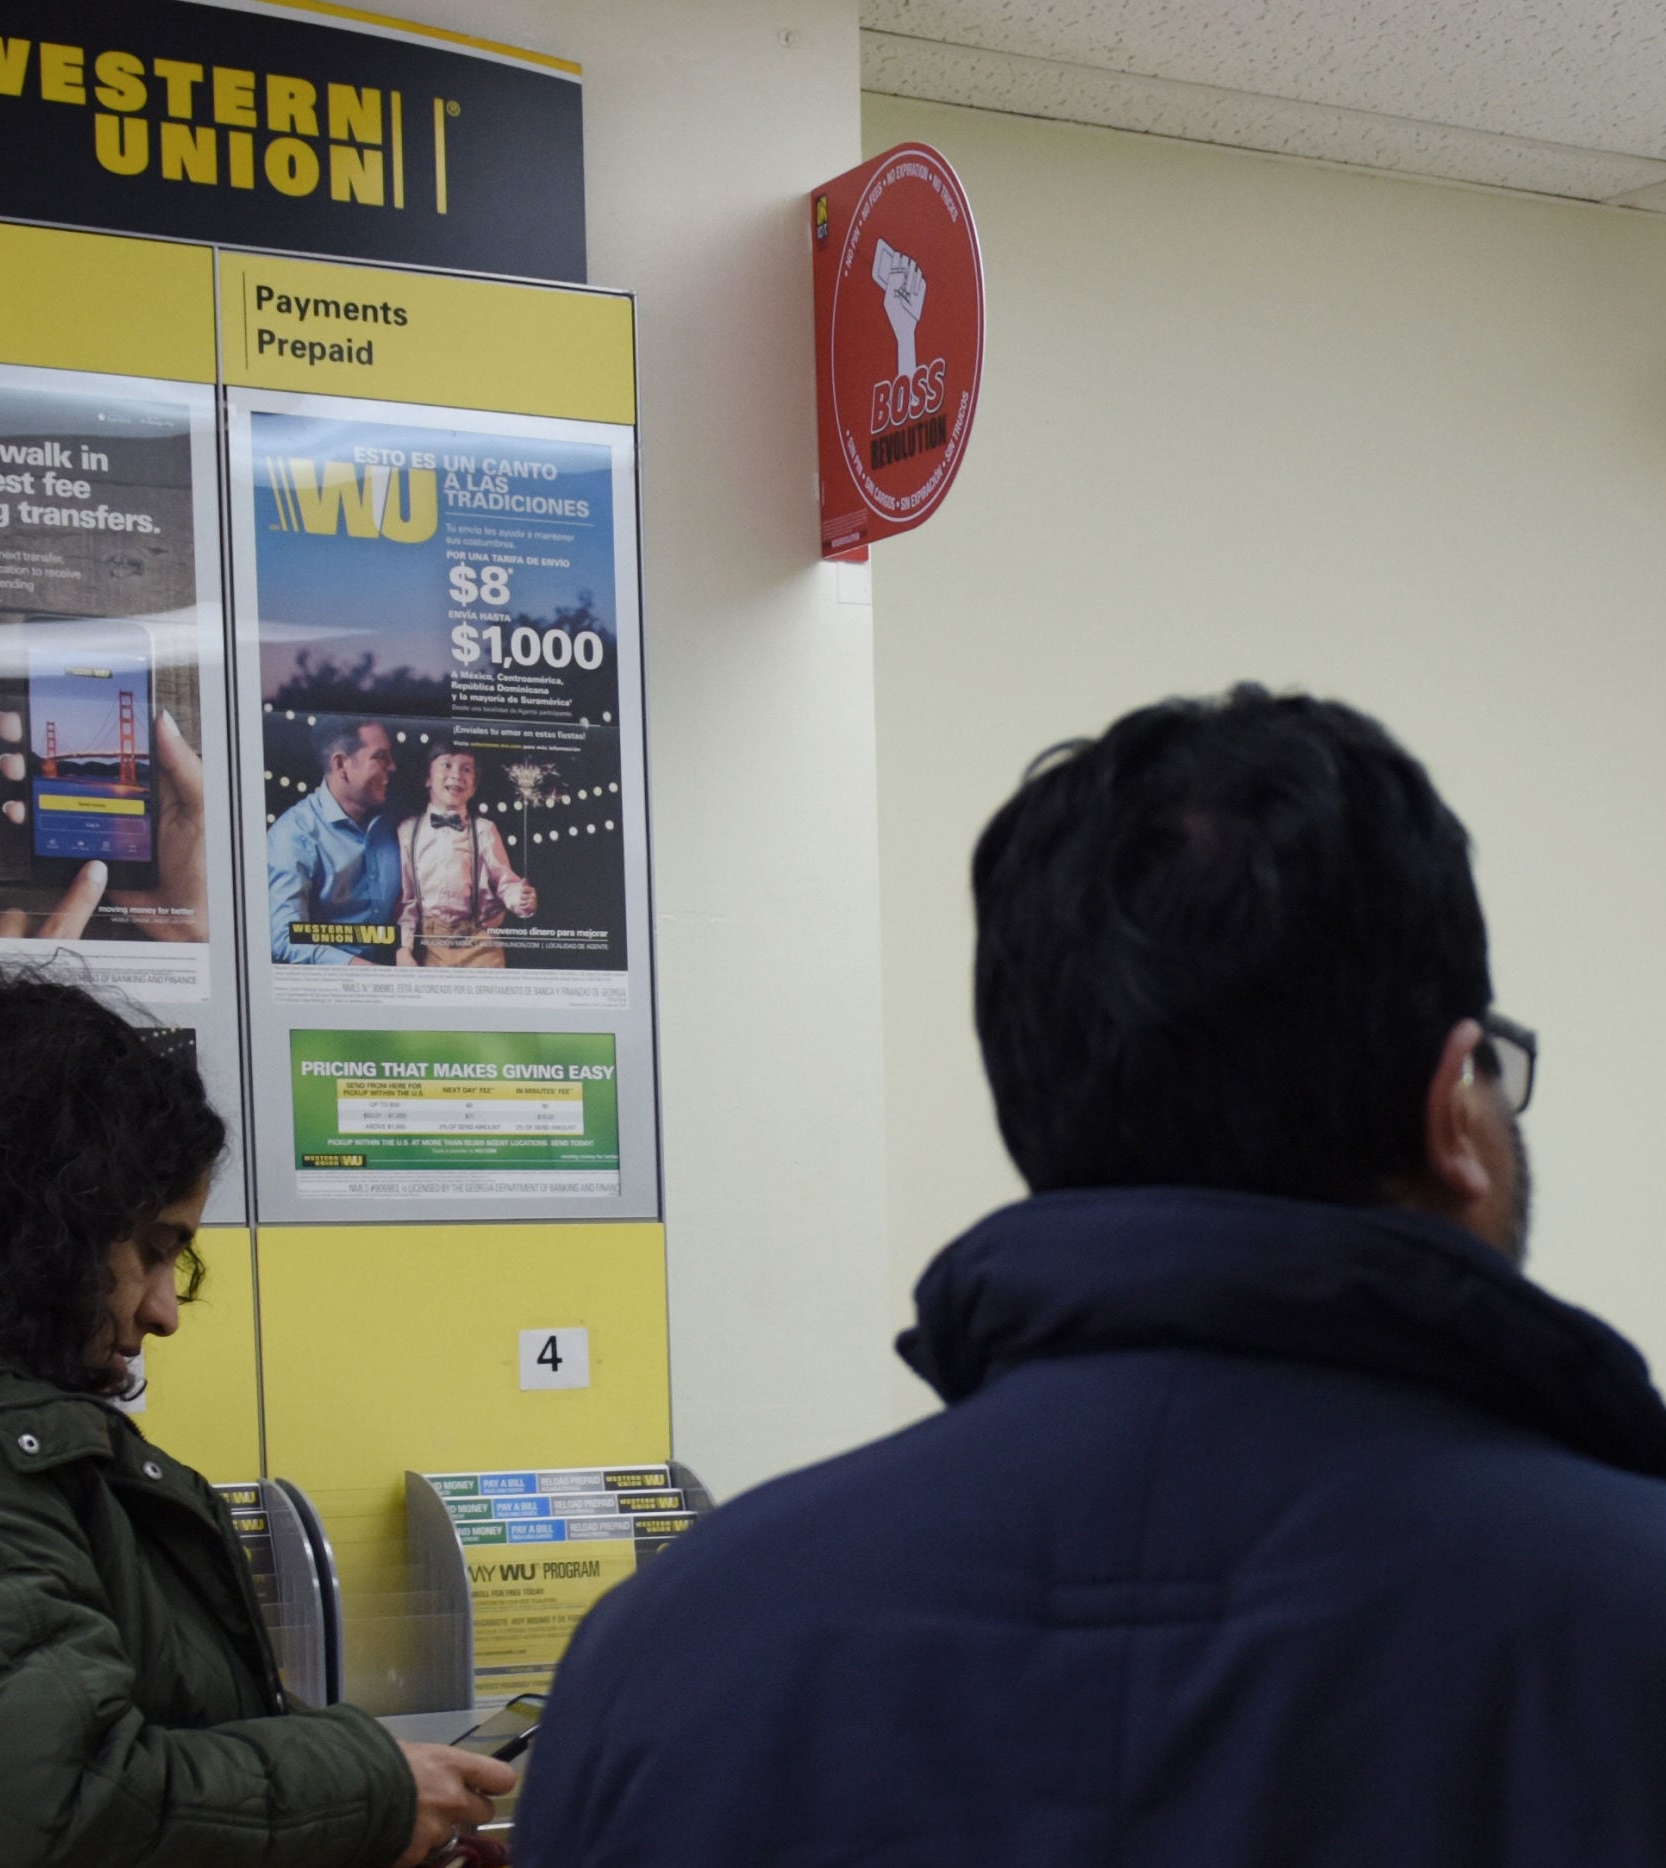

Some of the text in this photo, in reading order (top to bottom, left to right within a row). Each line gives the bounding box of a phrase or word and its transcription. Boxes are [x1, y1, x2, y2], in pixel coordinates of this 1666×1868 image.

[95, 113, 384, 207] UNION
[255, 285, 409, 328] Payments
[256, 329, 374, 367] Prepaid
[870, 357, 946, 435] BOSS
[870, 415, 946, 470] REVOLUTION
[80, 445, 109, 471] in
[353, 446, 557, 481] ESTO ES UN CANTO
[42, 473, 92, 500] fee
[444, 472, 509, 494] A LAS
[289, 457, 438, 544] WU
[444, 490, 590, 518] TRADICIONES
[18, 501, 161, 534] transfers.
[479, 611, 512, 623] HASTA
[451, 620, 604, 670] $1,000
[291, 923, 353, 934] WESTERN
[311, 933, 353, 943] UNION
[359, 925, 396, 944] WU
[300, 1061, 615, 1080] PRICING THAT MAKES GIVING EASY
[536, 1334, 564, 1372] 4
[512, 1524, 528, 1535] PAY
[536, 1522, 555, 1533] BILL
[499, 1563, 536, 1582] WU
[543, 1560, 600, 1580] PROGRAM
